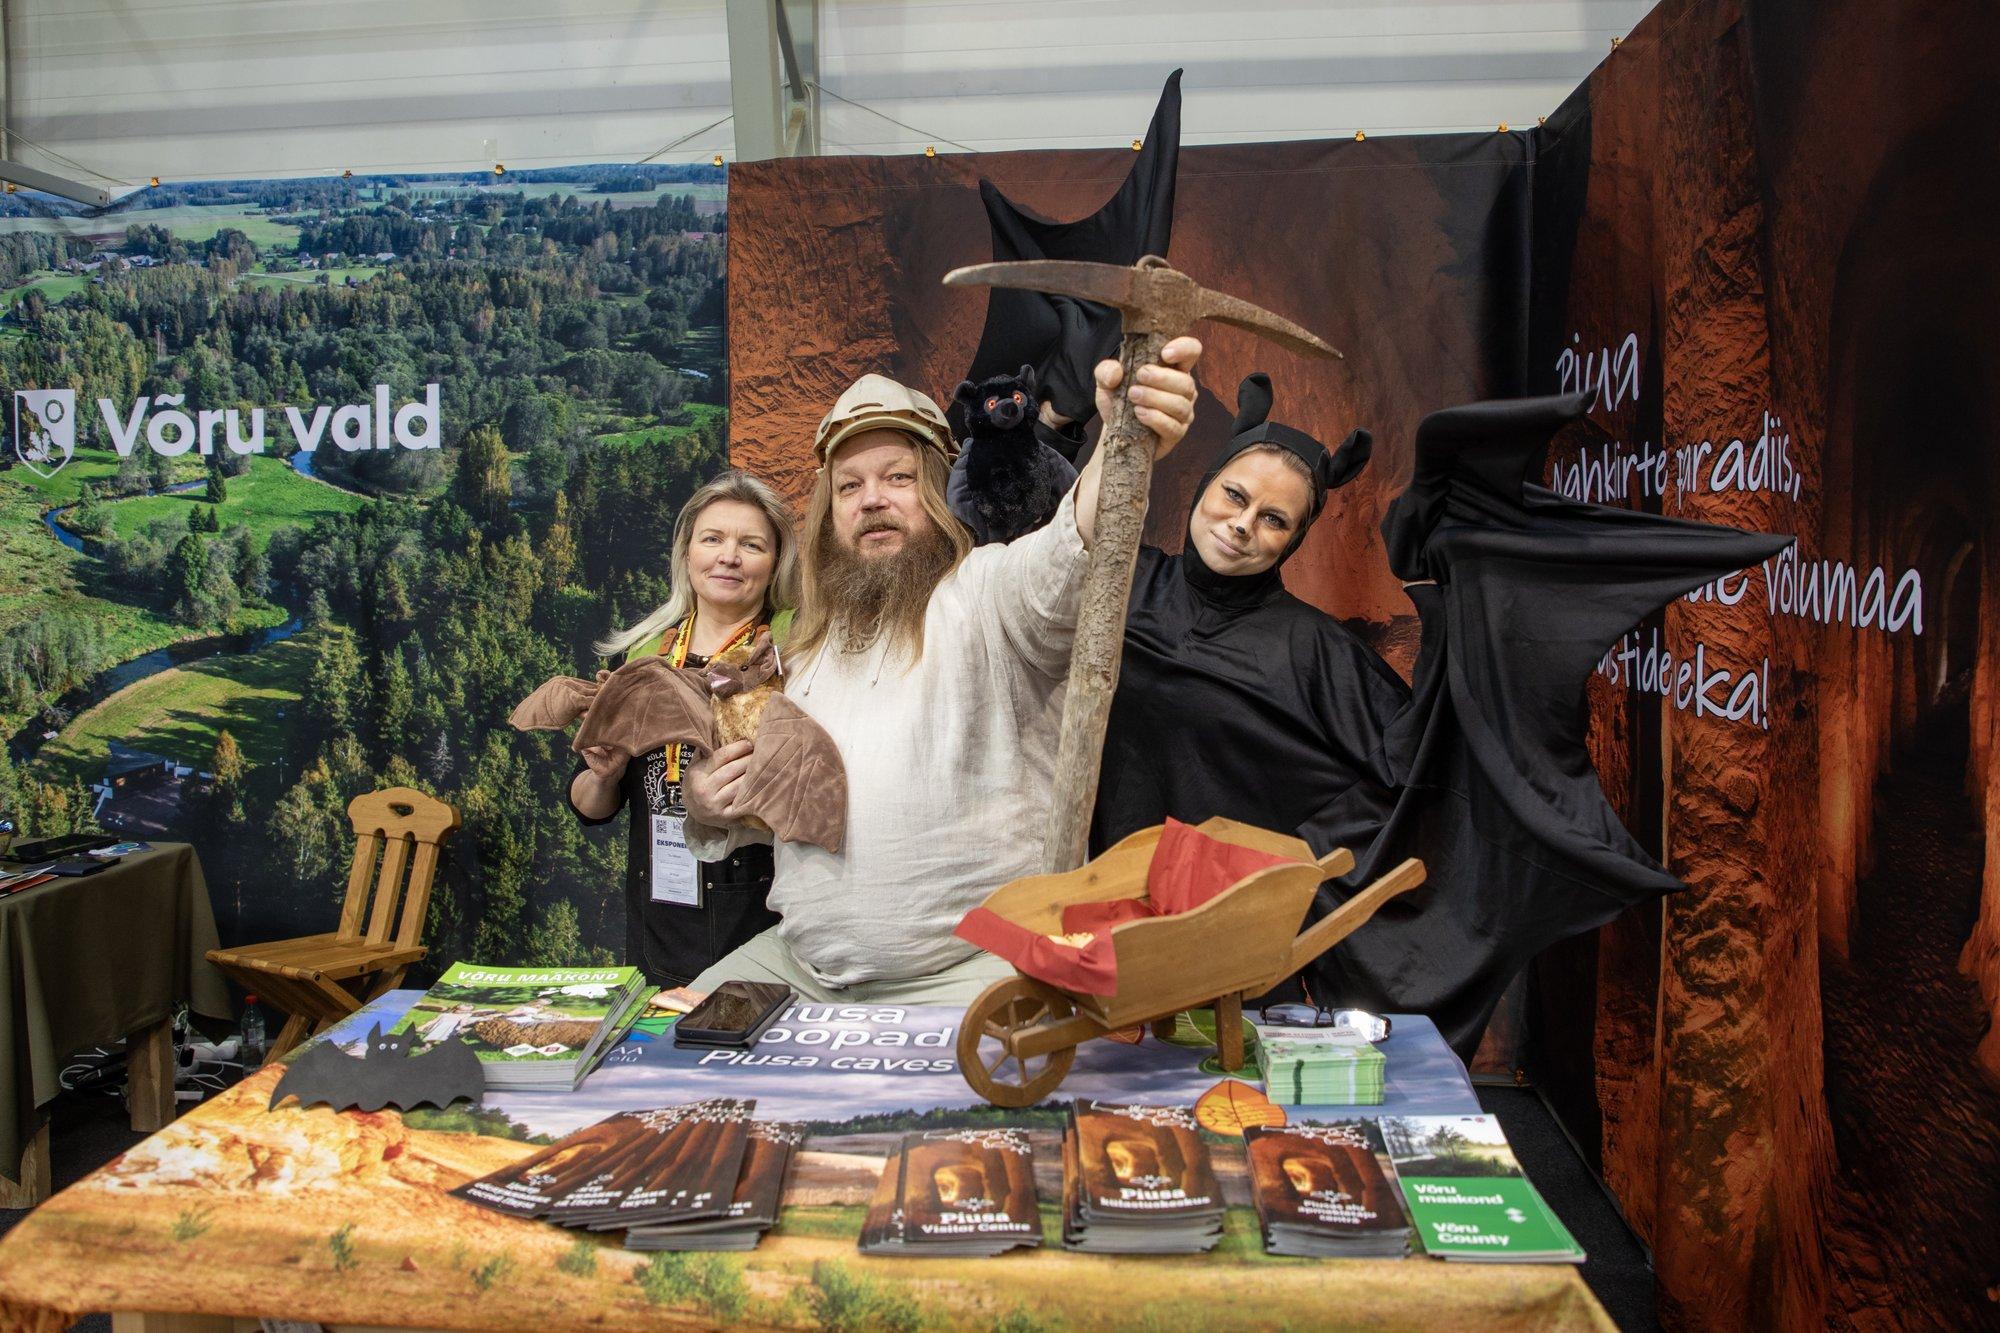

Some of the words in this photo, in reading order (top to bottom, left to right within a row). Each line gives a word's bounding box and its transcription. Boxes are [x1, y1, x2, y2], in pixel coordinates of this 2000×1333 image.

[98, 393, 265, 458] Võru
[285, 383, 441, 452] vald
[1763, 536, 1923, 635] Võlumaa
[458, 970, 511, 982] VÕRU
[516, 972, 620, 983] MAAKOND
[778, 1003, 907, 1025] iusa
[758, 1026, 954, 1051] oopad
[698, 1049, 821, 1068] Piusa
[830, 1055, 956, 1073] caves
[1119, 1187, 1187, 1200] Piusa
[1412, 1183, 1458, 1195] Võru
[1417, 1194, 1505, 1205] maakond
[938, 1211, 1011, 1225] Piusa
[921, 1223, 975, 1234] Visitor
[977, 1221, 1031, 1232] Centre
[1431, 1222, 1480, 1234] Võru
[1437, 1234, 1511, 1247] County
